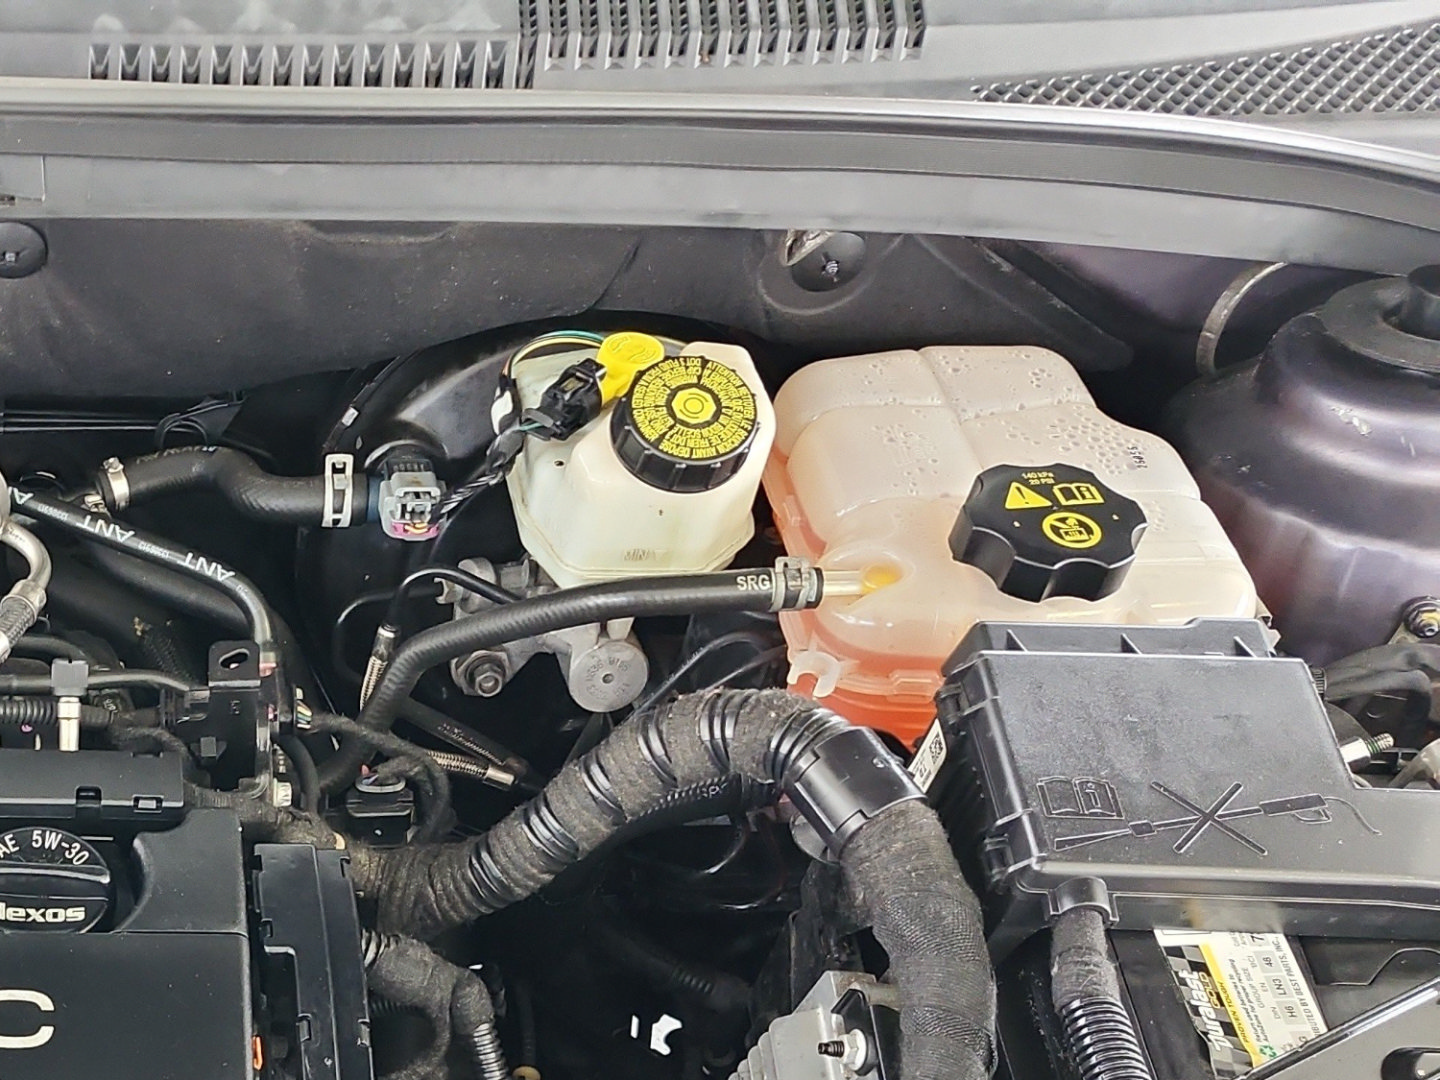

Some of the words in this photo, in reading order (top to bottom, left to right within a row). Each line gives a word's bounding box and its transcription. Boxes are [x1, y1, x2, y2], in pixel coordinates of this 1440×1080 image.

[76, 515, 135, 543] ANT
[177, 552, 235, 582] ANT
[736, 575, 770, 590] SRG
[31, 830, 90, 866] 5W-30
[1262, 956, 1274, 967] 48
[1198, 972, 1220, 1007] GOLD
[1219, 981, 1233, 1006] TOUGH
[1272, 977, 1287, 995] LN3
[1289, 978, 1303, 995] BEST
[1179, 970, 1227, 1050] Duralast
[1284, 1004, 1297, 1017] H6
[1297, 996, 1308, 1005] BY
[1231, 1010, 1249, 1042] PROVEN
